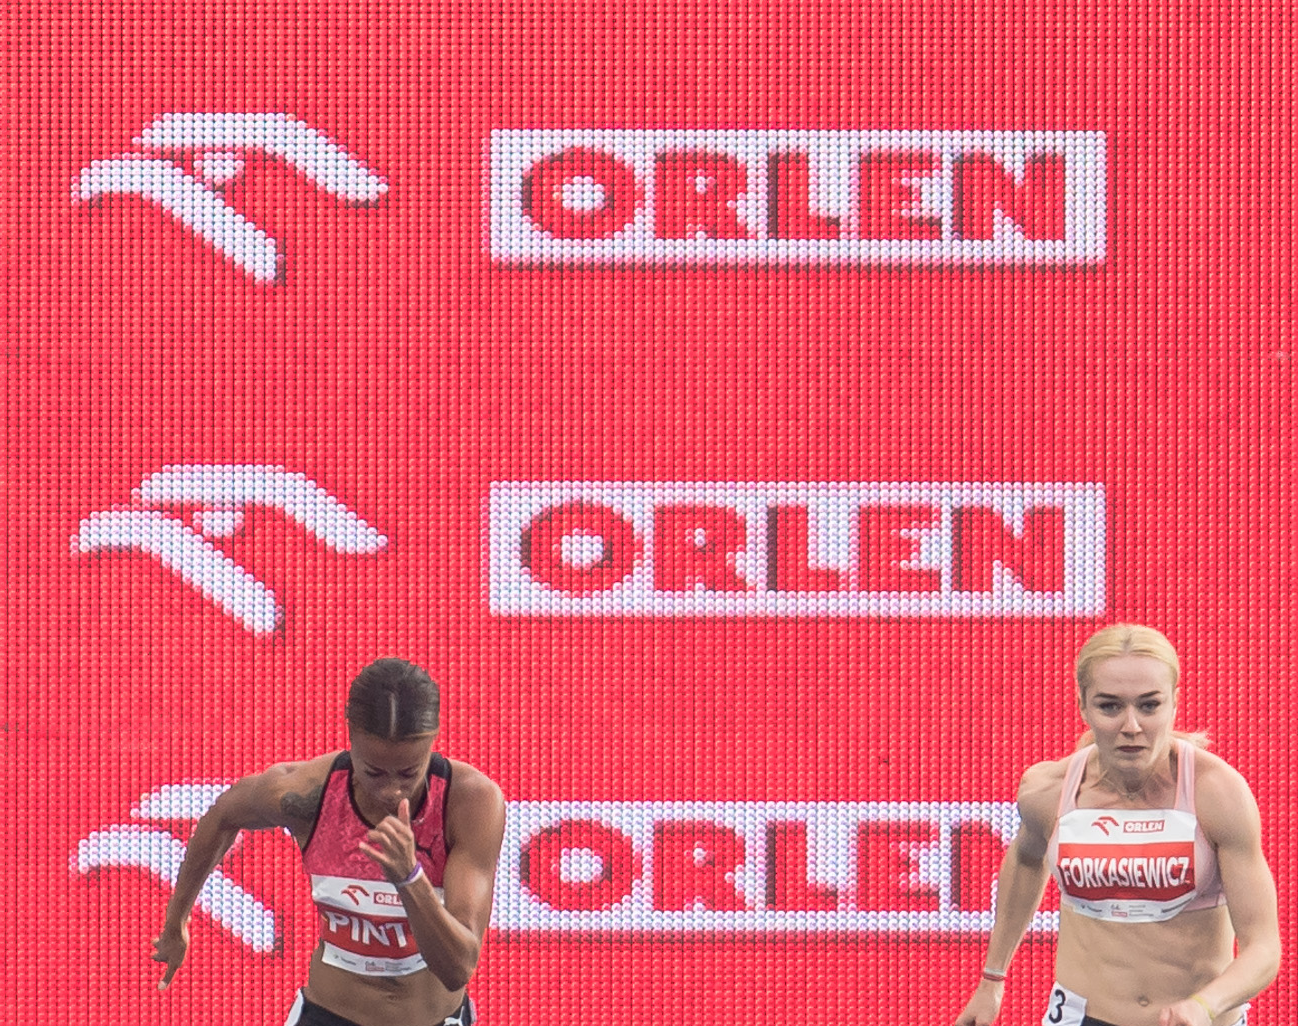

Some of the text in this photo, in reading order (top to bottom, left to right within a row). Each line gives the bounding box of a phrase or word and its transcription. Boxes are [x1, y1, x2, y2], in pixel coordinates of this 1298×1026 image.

[520, 146, 1066, 241] ORLEN
[520, 500, 1066, 595] ORLEN
[1124, 821, 1163, 832] ORLEN
[1060, 857, 1191, 888] FORKASIEWICZ
[375, 893, 403, 905] ORL
[325, 910, 407, 948] PINT
[1048, 989, 1067, 1024] 3
